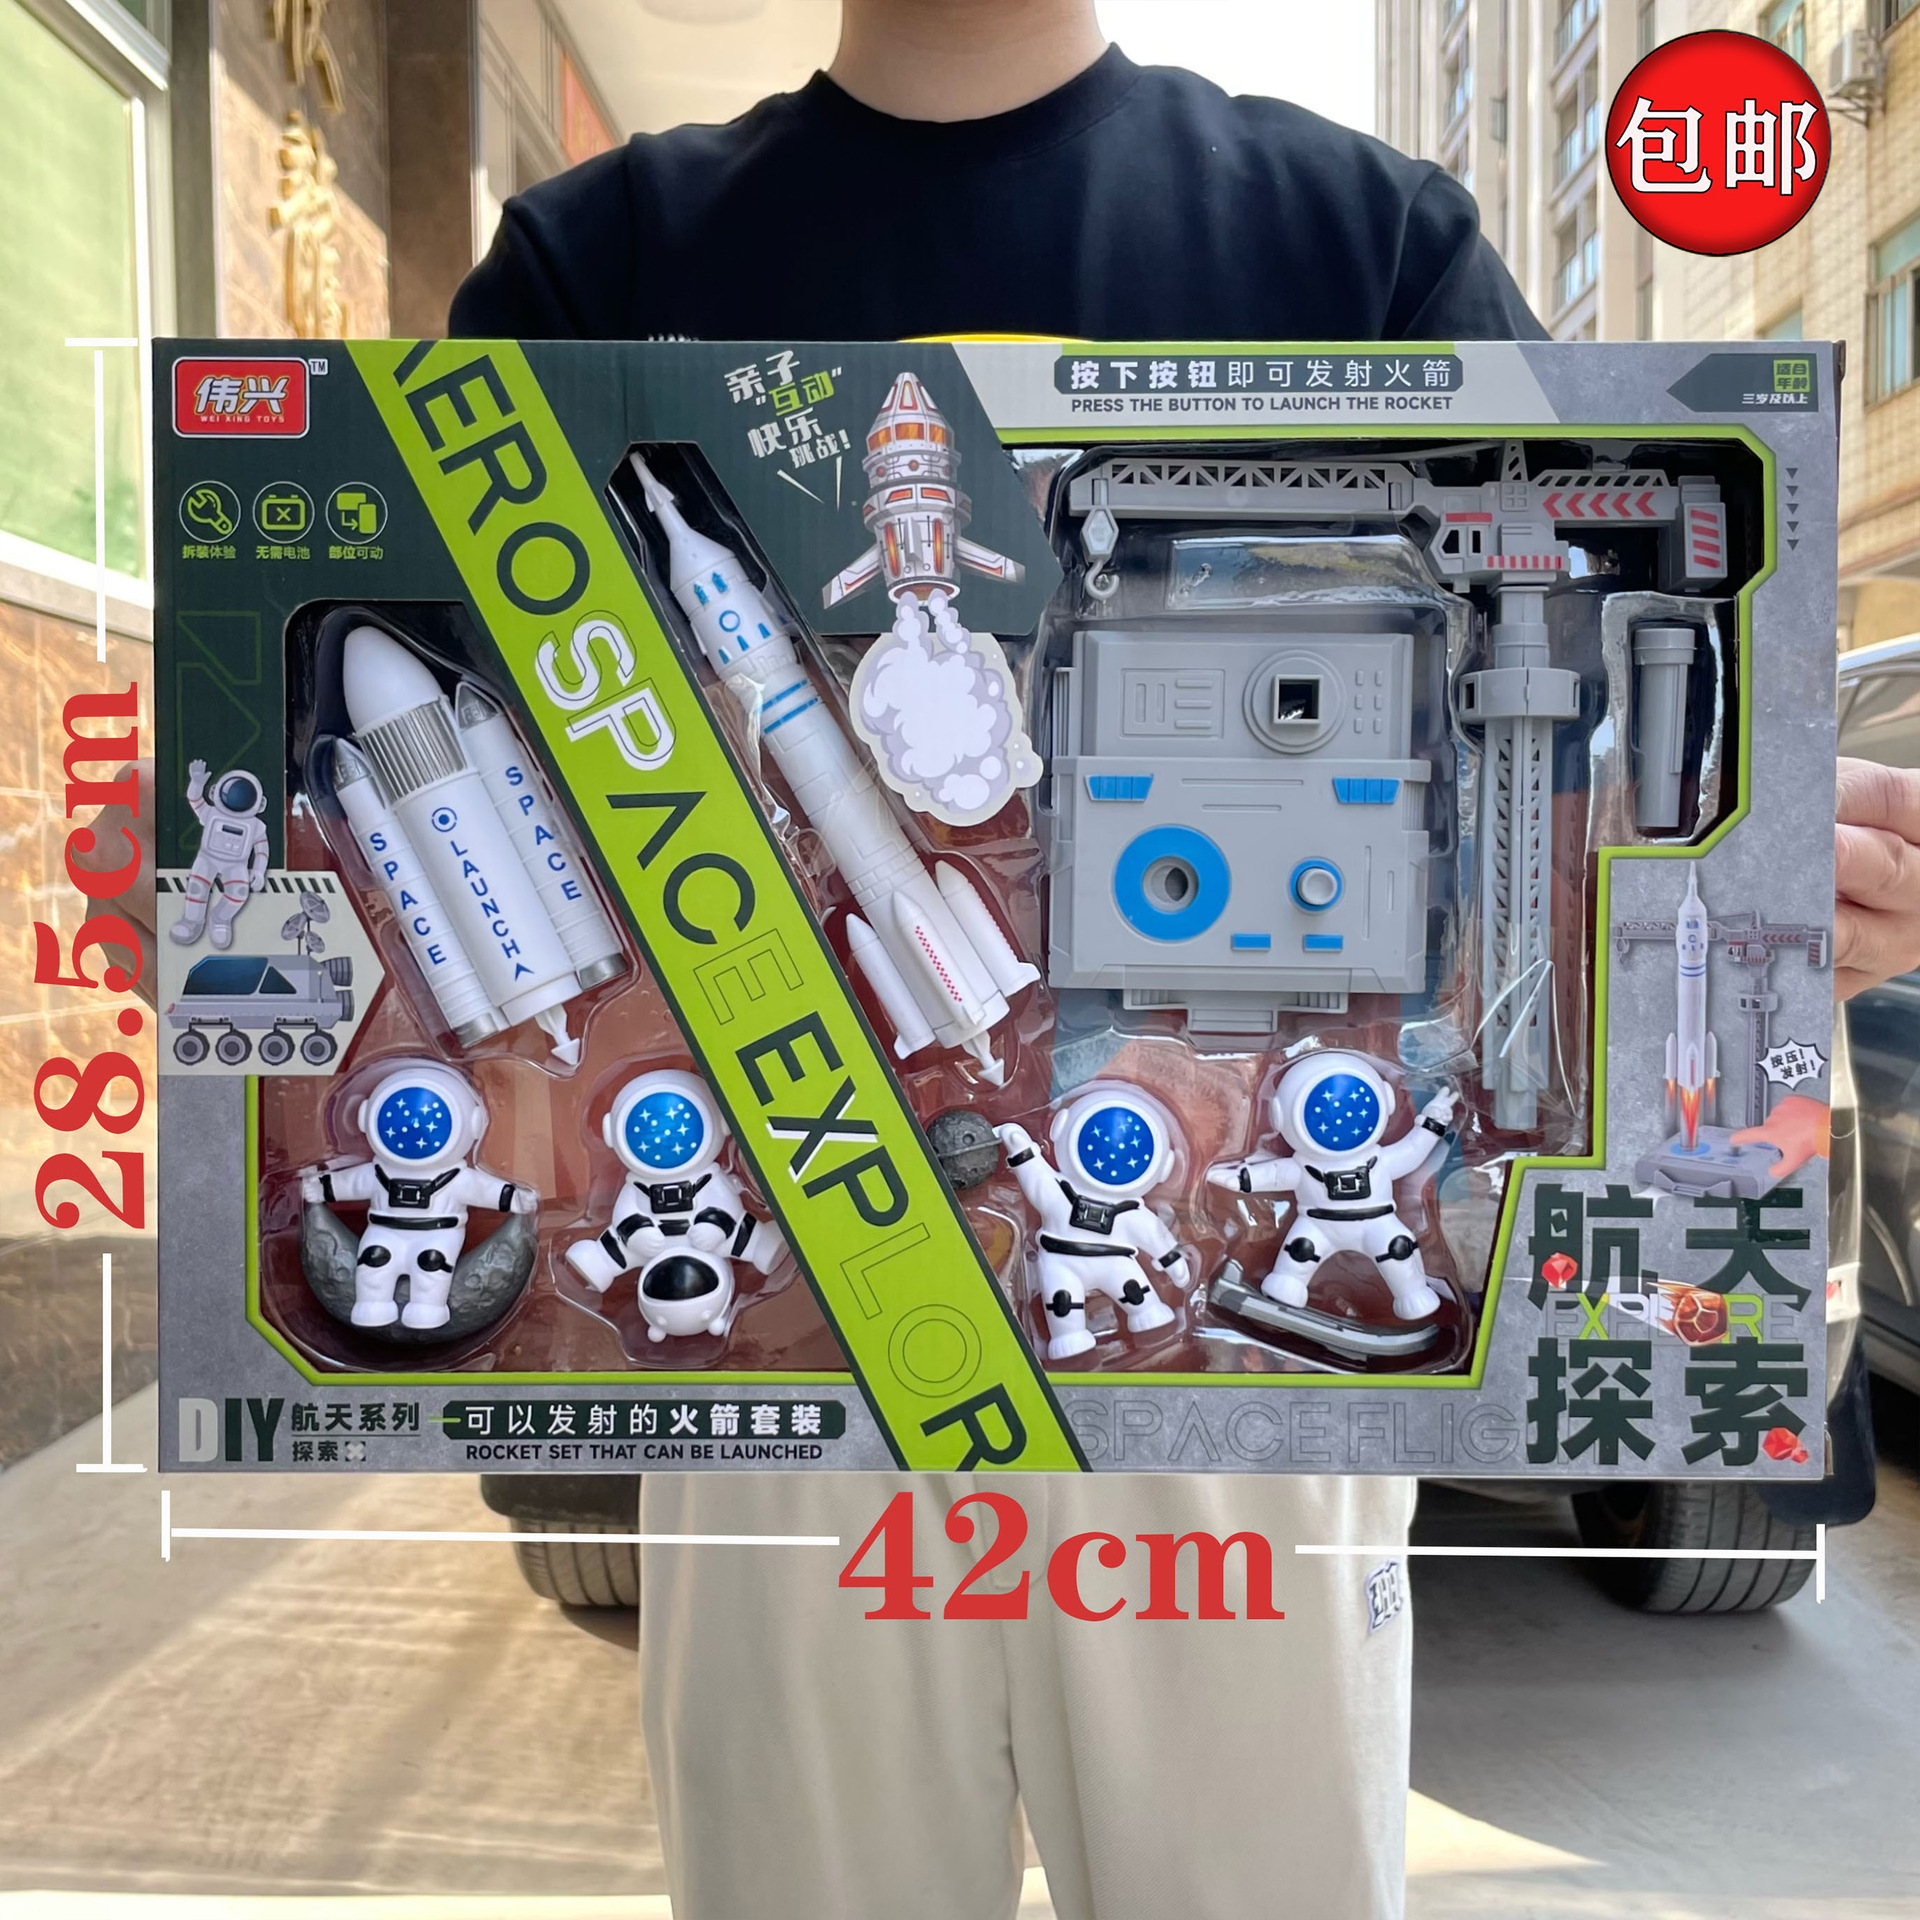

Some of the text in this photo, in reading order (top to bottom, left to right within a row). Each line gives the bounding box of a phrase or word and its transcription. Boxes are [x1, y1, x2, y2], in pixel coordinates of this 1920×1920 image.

[310, 360, 326, 373] TM
[724, 350, 800, 403] 亲子
[1070, 359, 1451, 389] 按下按钮即可发射火箭
[195, 375, 290, 414] 伟兴
[1071, 396, 1453, 412] PRESS THE BUTTON TO LAUNCH THE ROCKET
[1742, 393, 1808, 404] 三岁及以上
[200, 415, 285, 423] WEI XING TOYS
[747, 407, 823, 458] 快乐
[182, 545, 237, 560] 拆装体验
[256, 545, 311, 560] 无需电池
[328, 545, 384, 560] 部位可动
[505, 766, 582, 900] SPACE
[370, 832, 446, 965] SPACE
[1528, 1184, 1812, 1311] 航天
[1545, 1293, 1799, 1345] EXPLRE
[1526, 1336, 1811, 1466] 探索
[178, 1397, 285, 1463] DIY
[291, 1402, 421, 1432] 航天系列
[465, 1403, 822, 1436] 可以发射的火箭套装
[292, 1441, 339, 1462] 探索
[466, 1444, 823, 1460] ROCKET SET THAT CAN BE LAUNCHED
